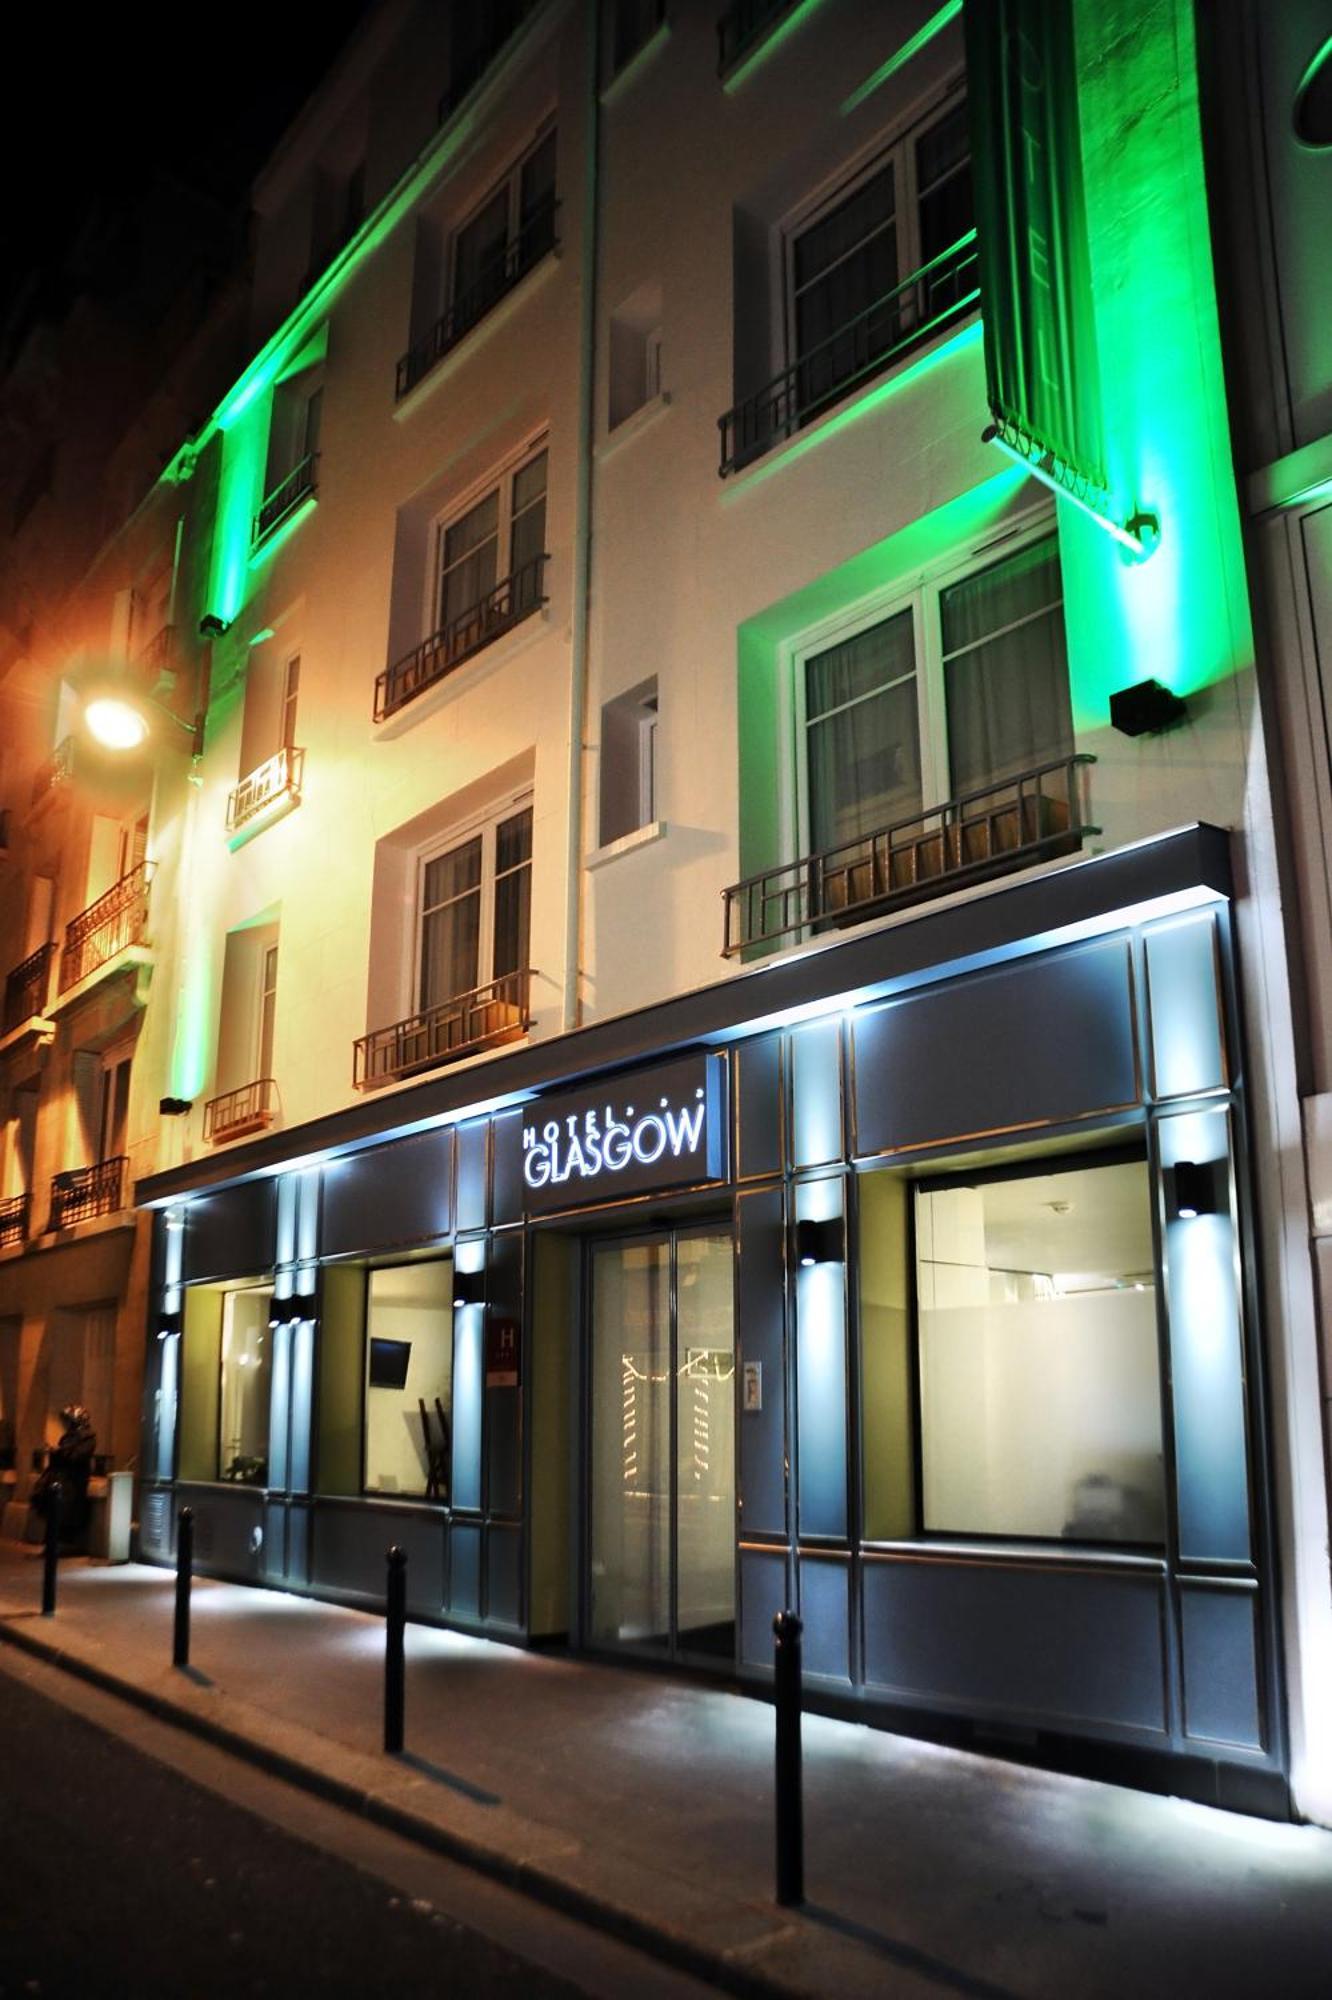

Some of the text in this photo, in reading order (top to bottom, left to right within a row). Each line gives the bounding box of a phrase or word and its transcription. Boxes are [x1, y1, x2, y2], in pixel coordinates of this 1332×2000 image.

[523, 1105, 615, 1149] HOTEL
[524, 1102, 705, 1188] GLASGOW
[501, 1327, 514, 1348] H
